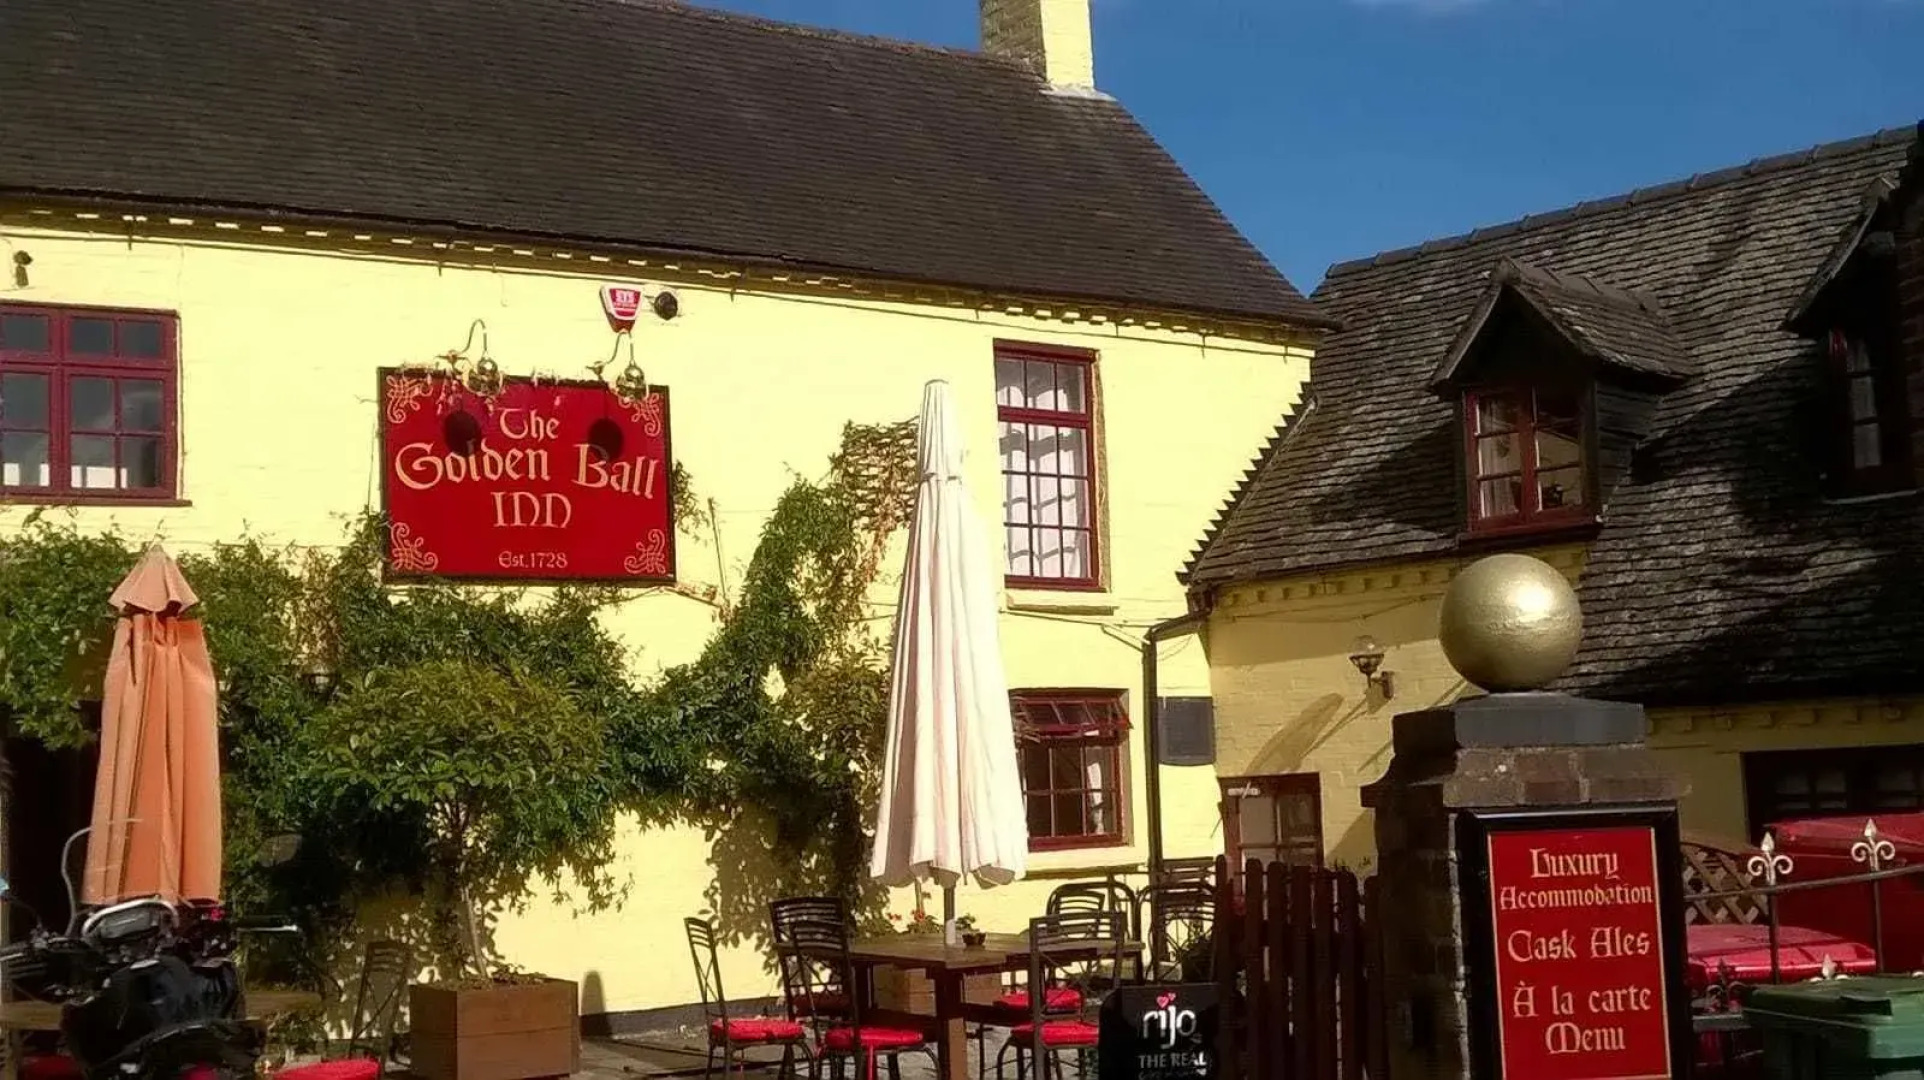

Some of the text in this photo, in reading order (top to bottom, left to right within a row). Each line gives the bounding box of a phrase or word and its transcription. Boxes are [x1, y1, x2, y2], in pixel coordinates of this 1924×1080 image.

[499, 407, 560, 442] The
[395, 438, 660, 499] Golden Ball
[1529, 848, 1620, 880] Luxury
[1500, 882, 1654, 910] Accommodation
[1508, 926, 1650, 962] Cask Ales
[1513, 981, 1651, 1018] À la carte
[1545, 1021, 1626, 1054] Menu
[1138, 1052, 1207, 1069] THE REAL
